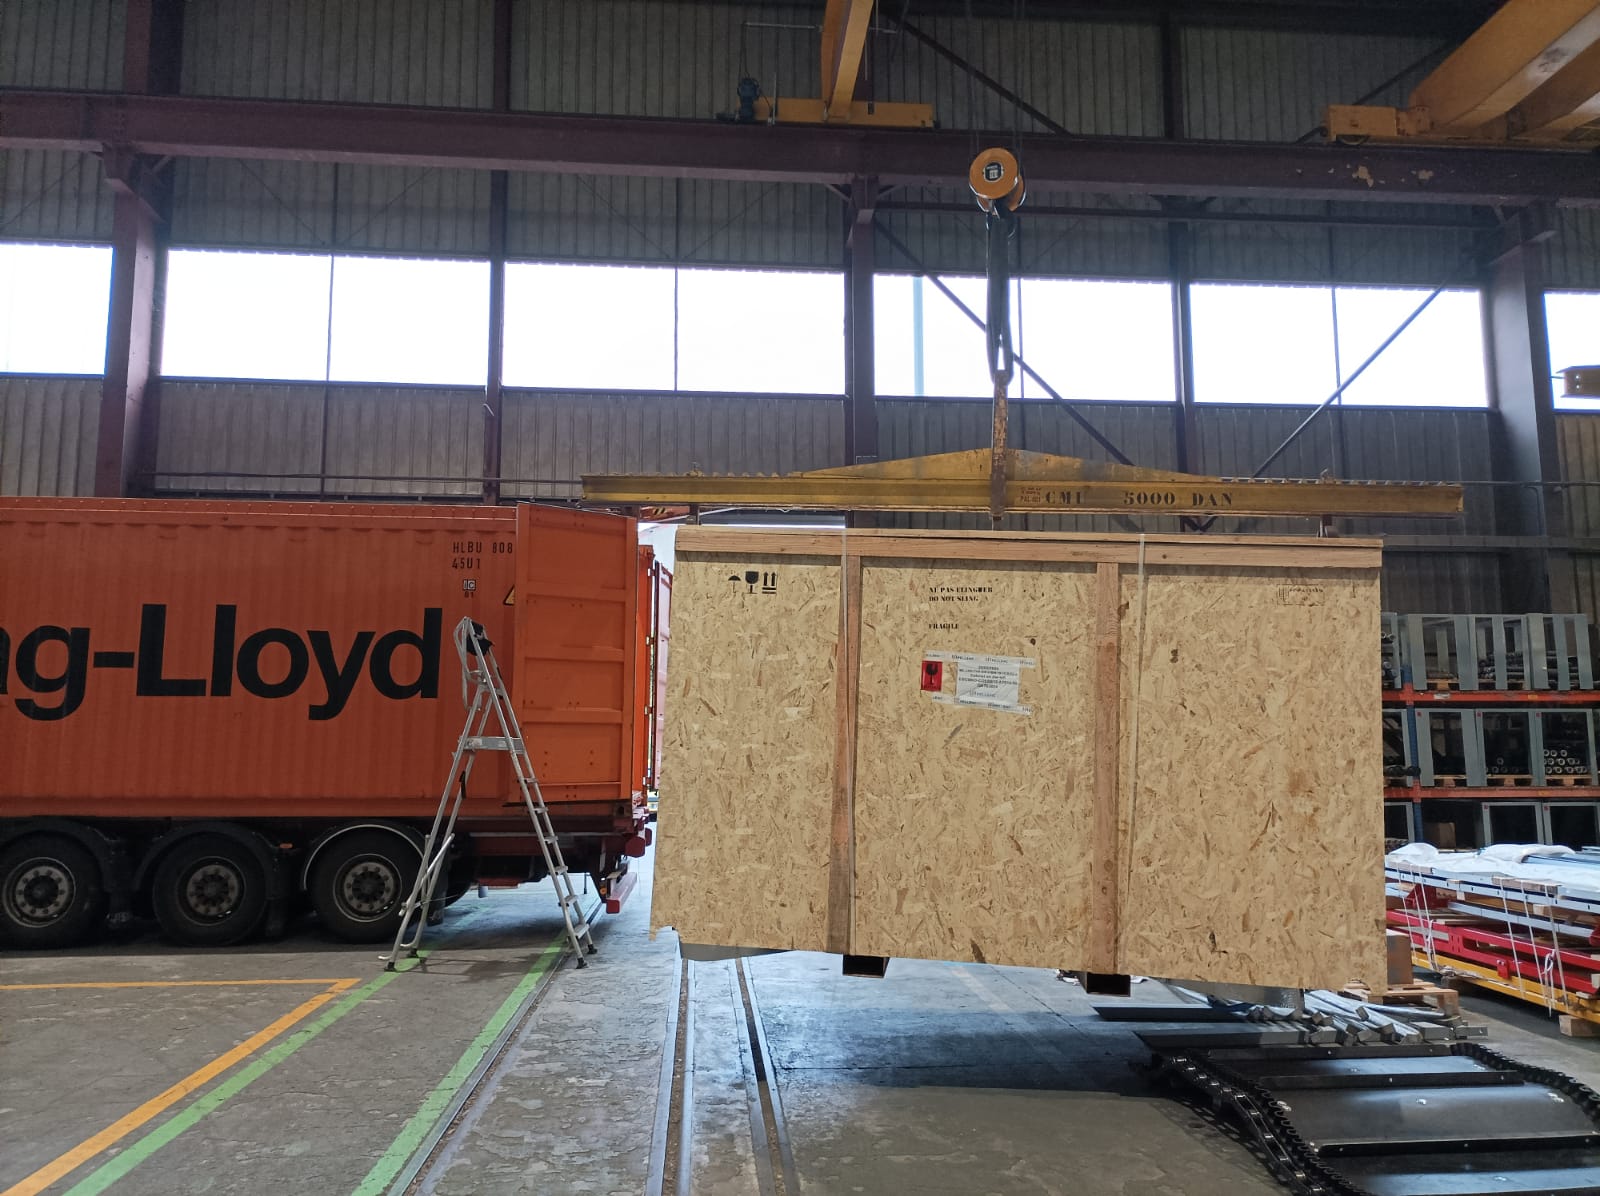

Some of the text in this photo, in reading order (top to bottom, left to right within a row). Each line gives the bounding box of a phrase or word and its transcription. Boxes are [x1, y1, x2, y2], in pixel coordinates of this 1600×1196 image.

[1123, 491, 1175, 506] 5000
[1191, 492, 1232, 506] DAN
[452, 541, 513, 554] HLBU 808
[451, 557, 481, 570] 45U1
[0, 604, 443, 721] g-Lloyd
